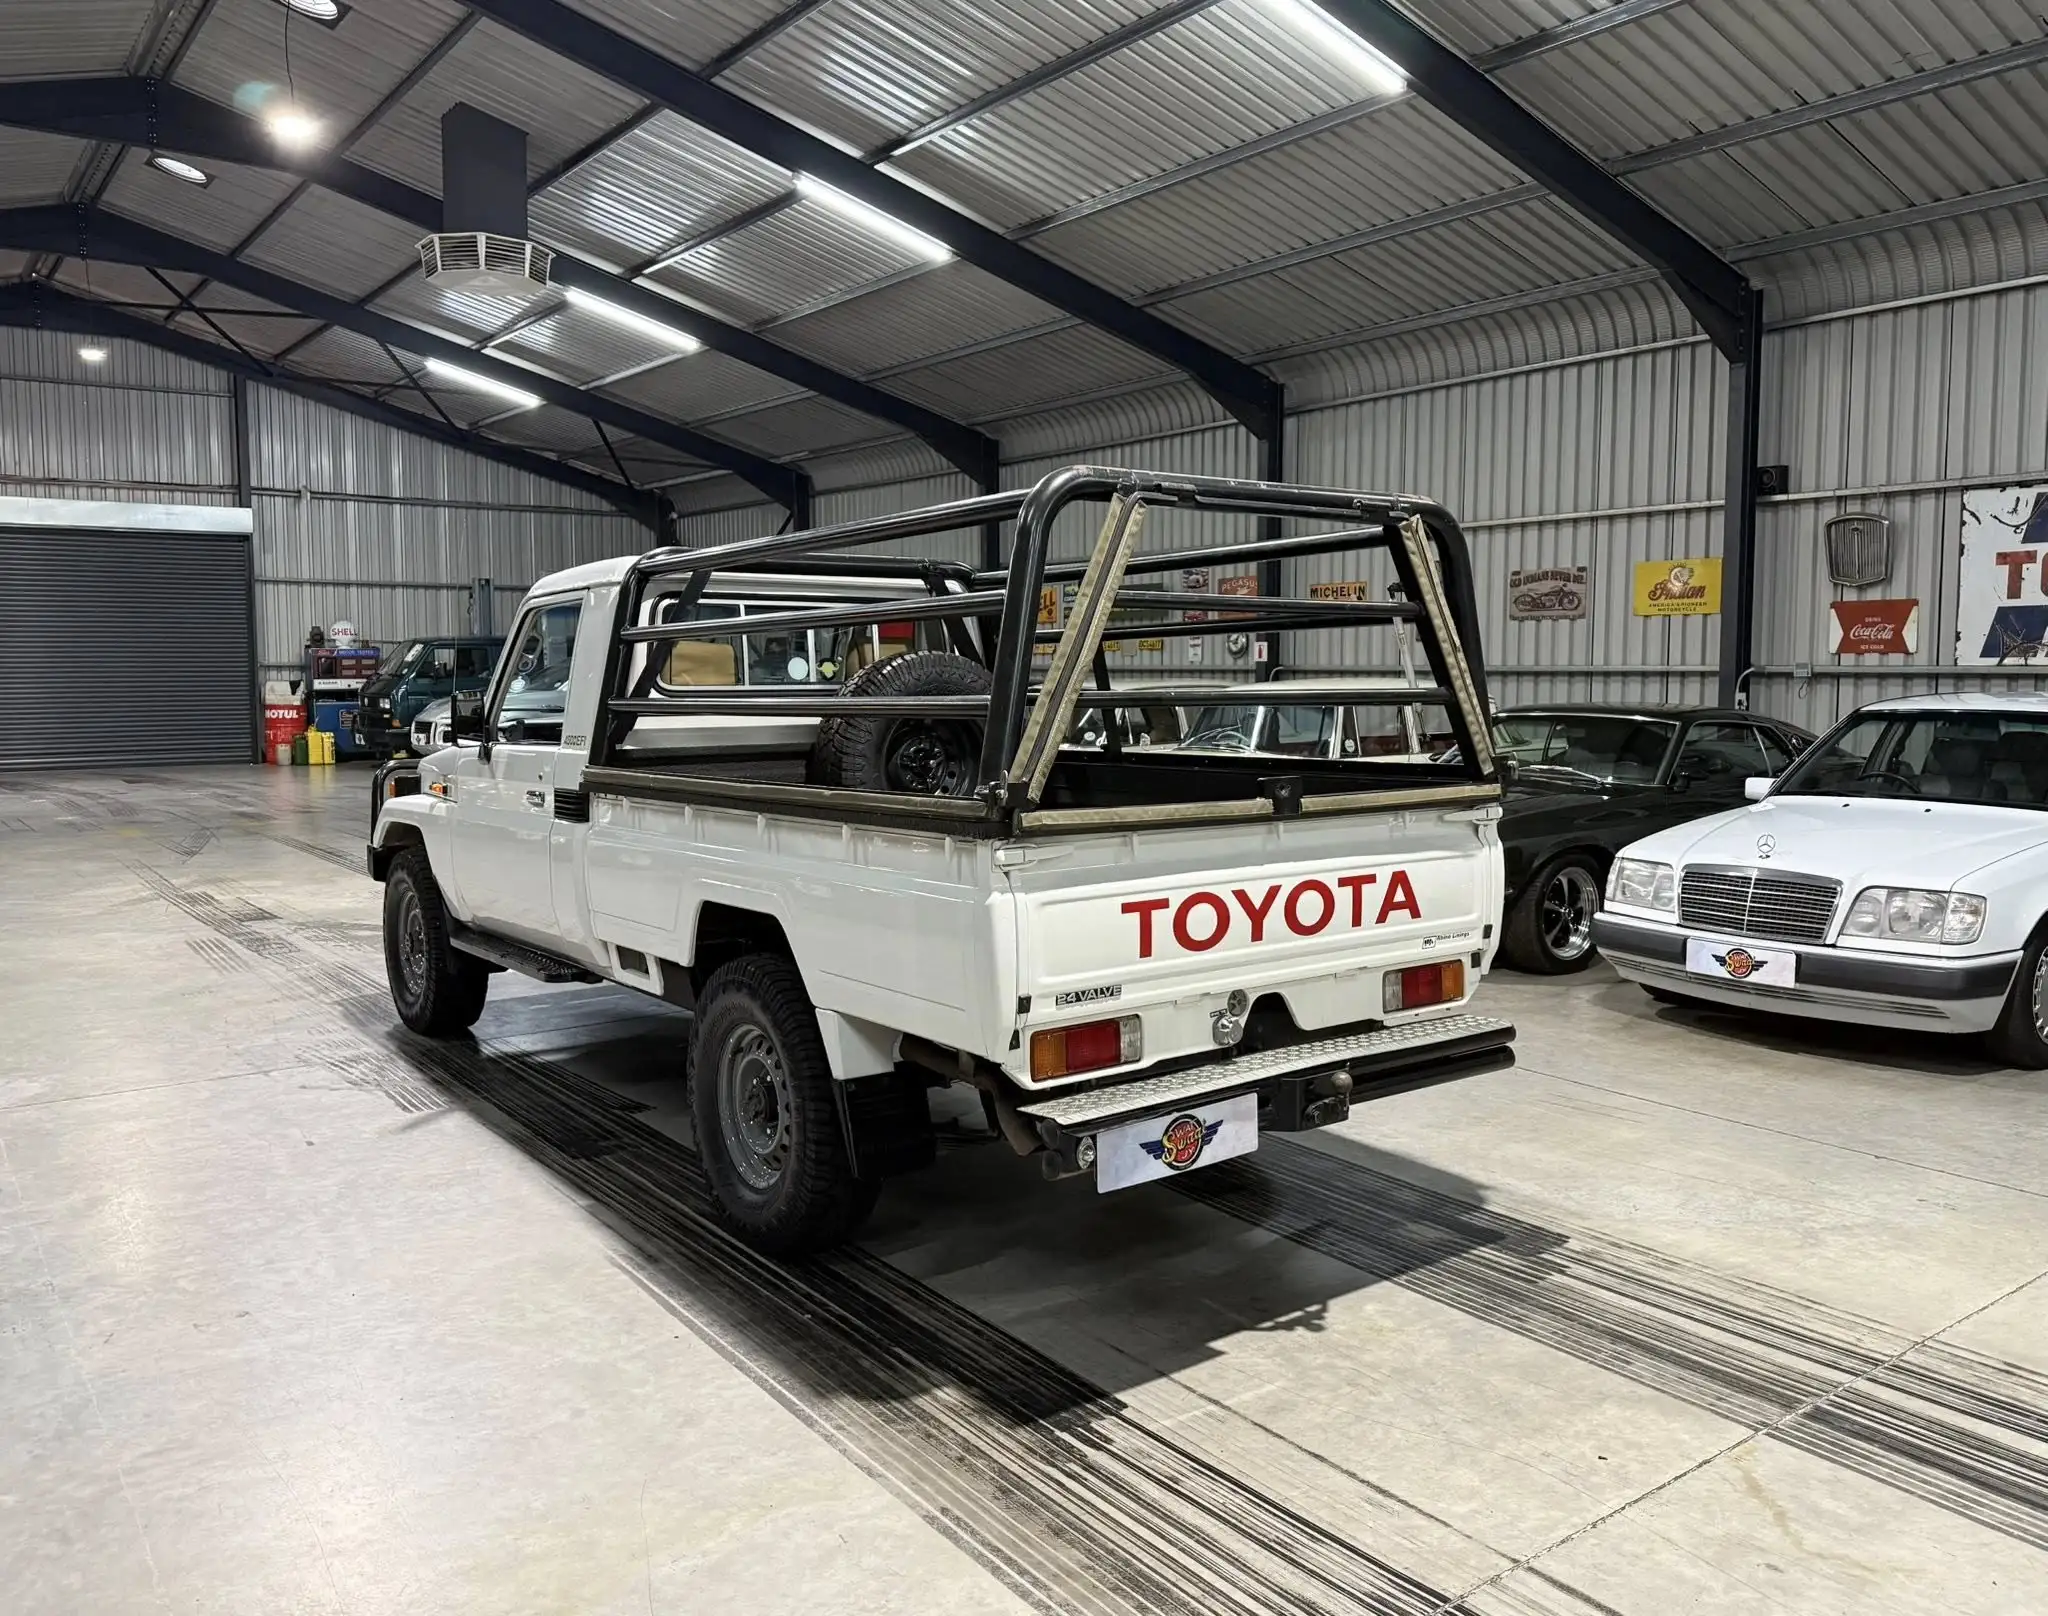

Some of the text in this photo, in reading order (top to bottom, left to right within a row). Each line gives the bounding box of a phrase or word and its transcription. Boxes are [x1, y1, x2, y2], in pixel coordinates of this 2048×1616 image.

[1996, 550, 2048, 600] T
[1310, 585, 1366, 599] MICHELIN
[1648, 579, 1706, 601] Indian
[331, 628, 358, 636] SHELL
[1121, 870, 1422, 959] TOYOTA
[1057, 985, 1122, 1005] 24 VALVE
